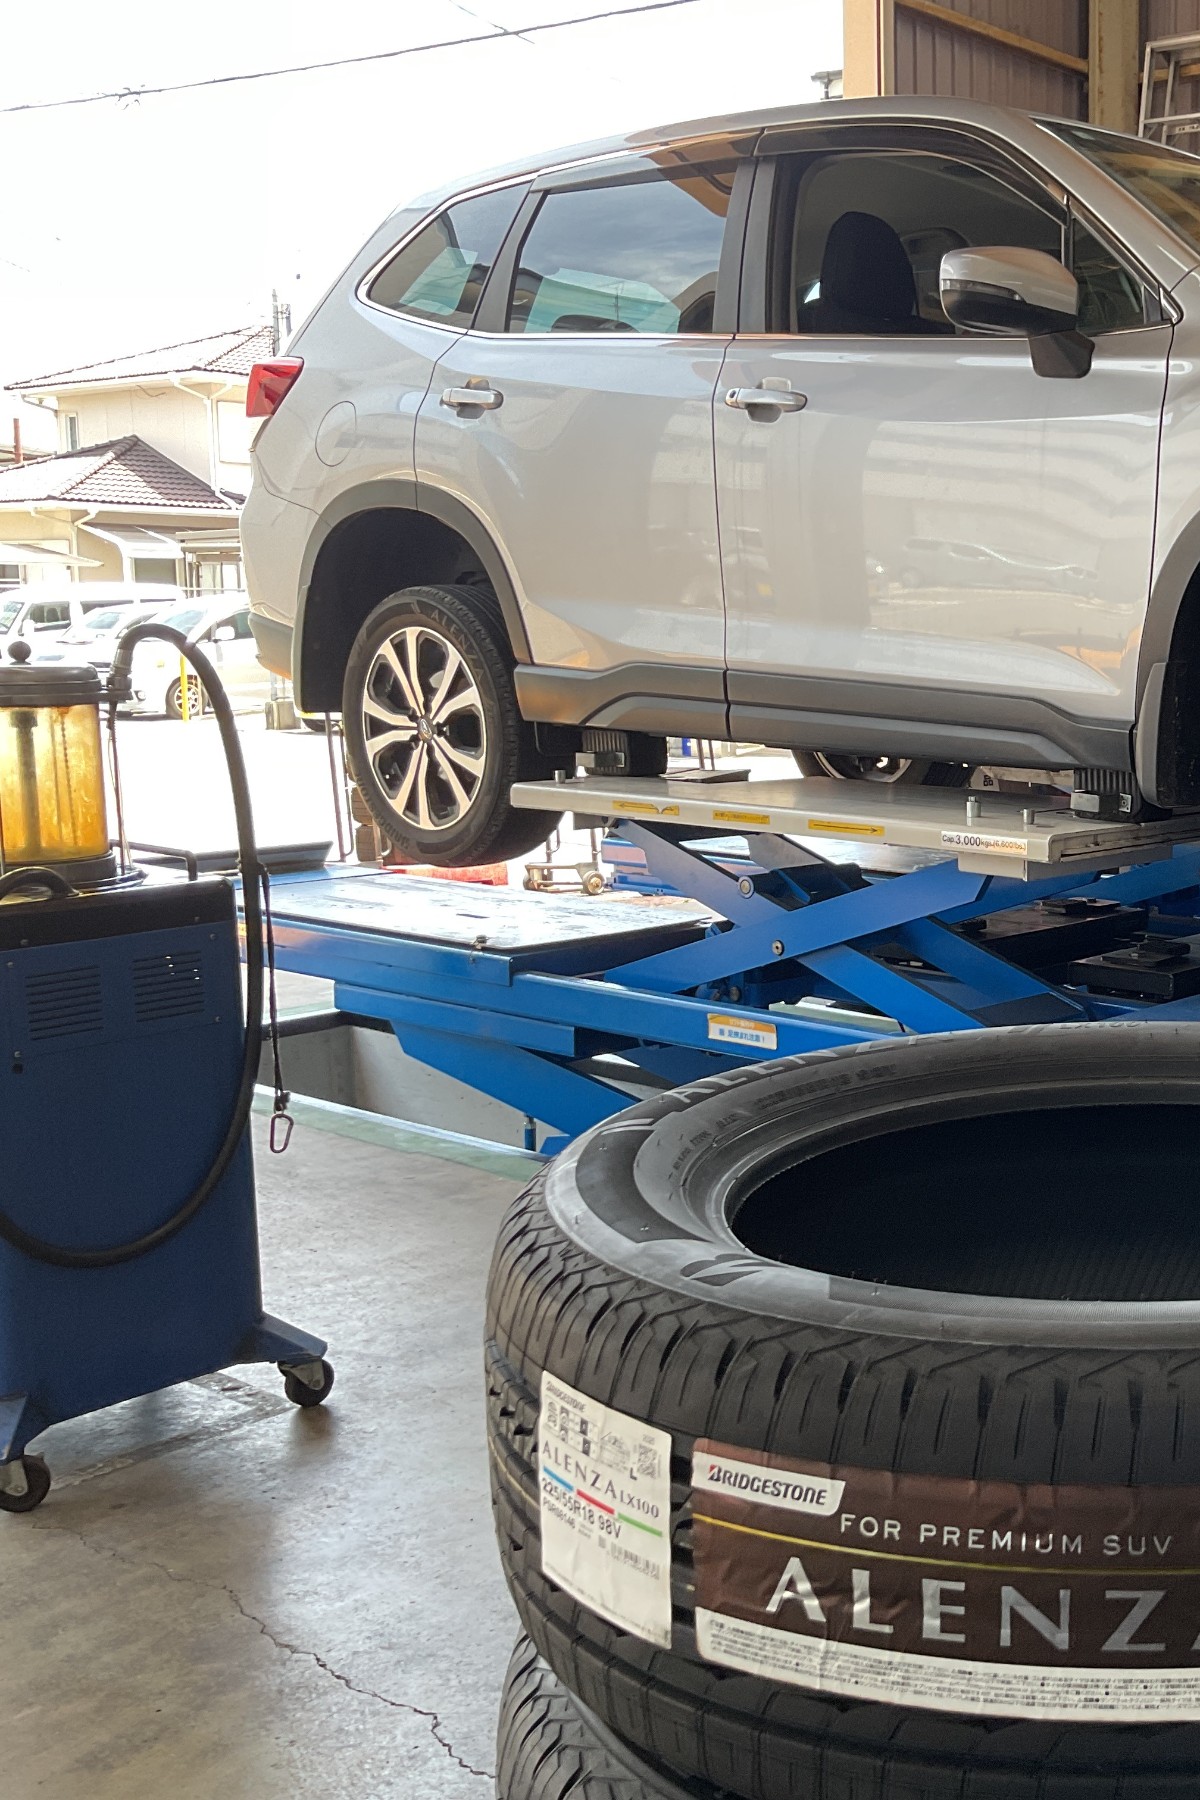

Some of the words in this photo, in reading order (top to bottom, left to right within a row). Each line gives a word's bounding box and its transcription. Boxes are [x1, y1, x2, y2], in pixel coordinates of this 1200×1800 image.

[542, 1440, 617, 1500] ALENZA
[620, 1489, 660, 1519] LX100
[707, 1464, 827, 1505] BRIDGESTONE
[542, 1477, 595, 1526] 225/55R18
[598, 1514, 622, 1539] 98V
[840, 1513, 901, 1541] FOR
[919, 1523, 1082, 1554] PREMIUM
[1102, 1534, 1173, 1556] SUV
